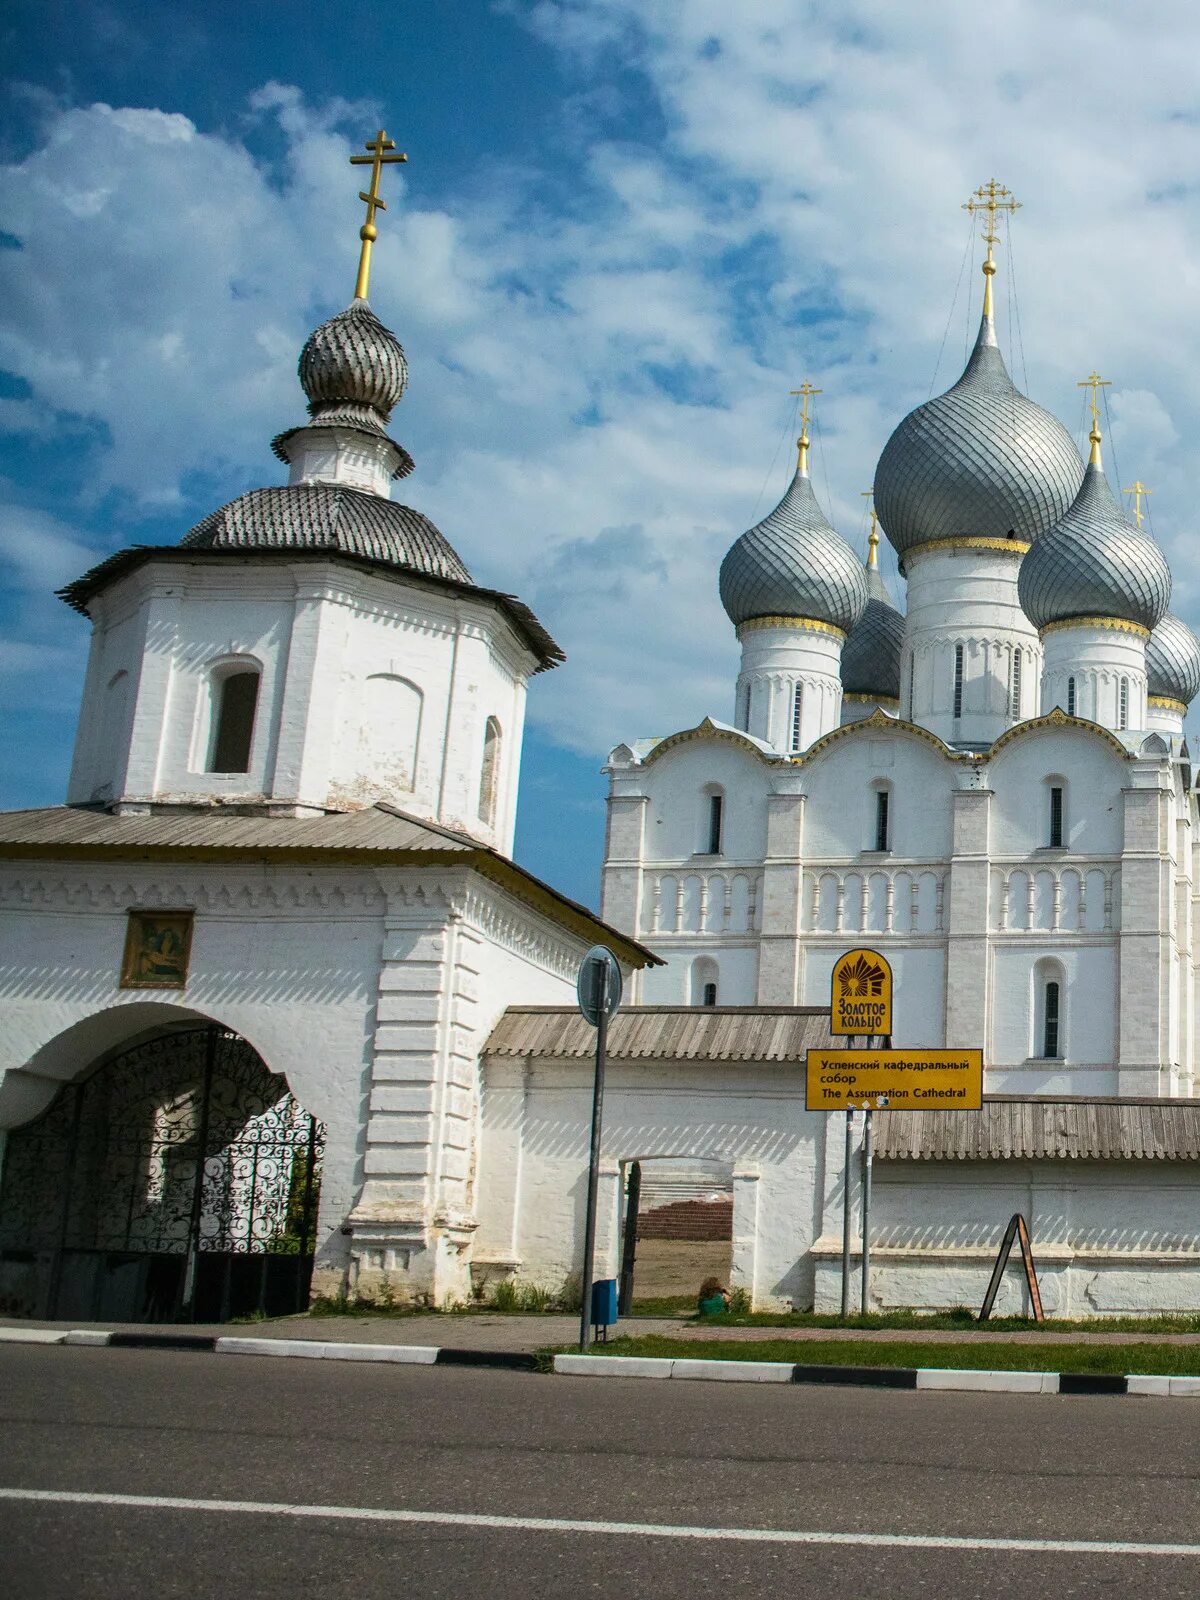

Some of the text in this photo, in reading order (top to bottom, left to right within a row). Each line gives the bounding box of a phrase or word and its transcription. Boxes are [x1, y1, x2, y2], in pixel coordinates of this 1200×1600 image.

[838, 998, 886, 1015] Золотое
[820, 1060, 970, 1071] Успенский кафедральный
[820, 1073, 857, 1084] собор
[822, 1087, 966, 1098] The Assumption Cathedral
